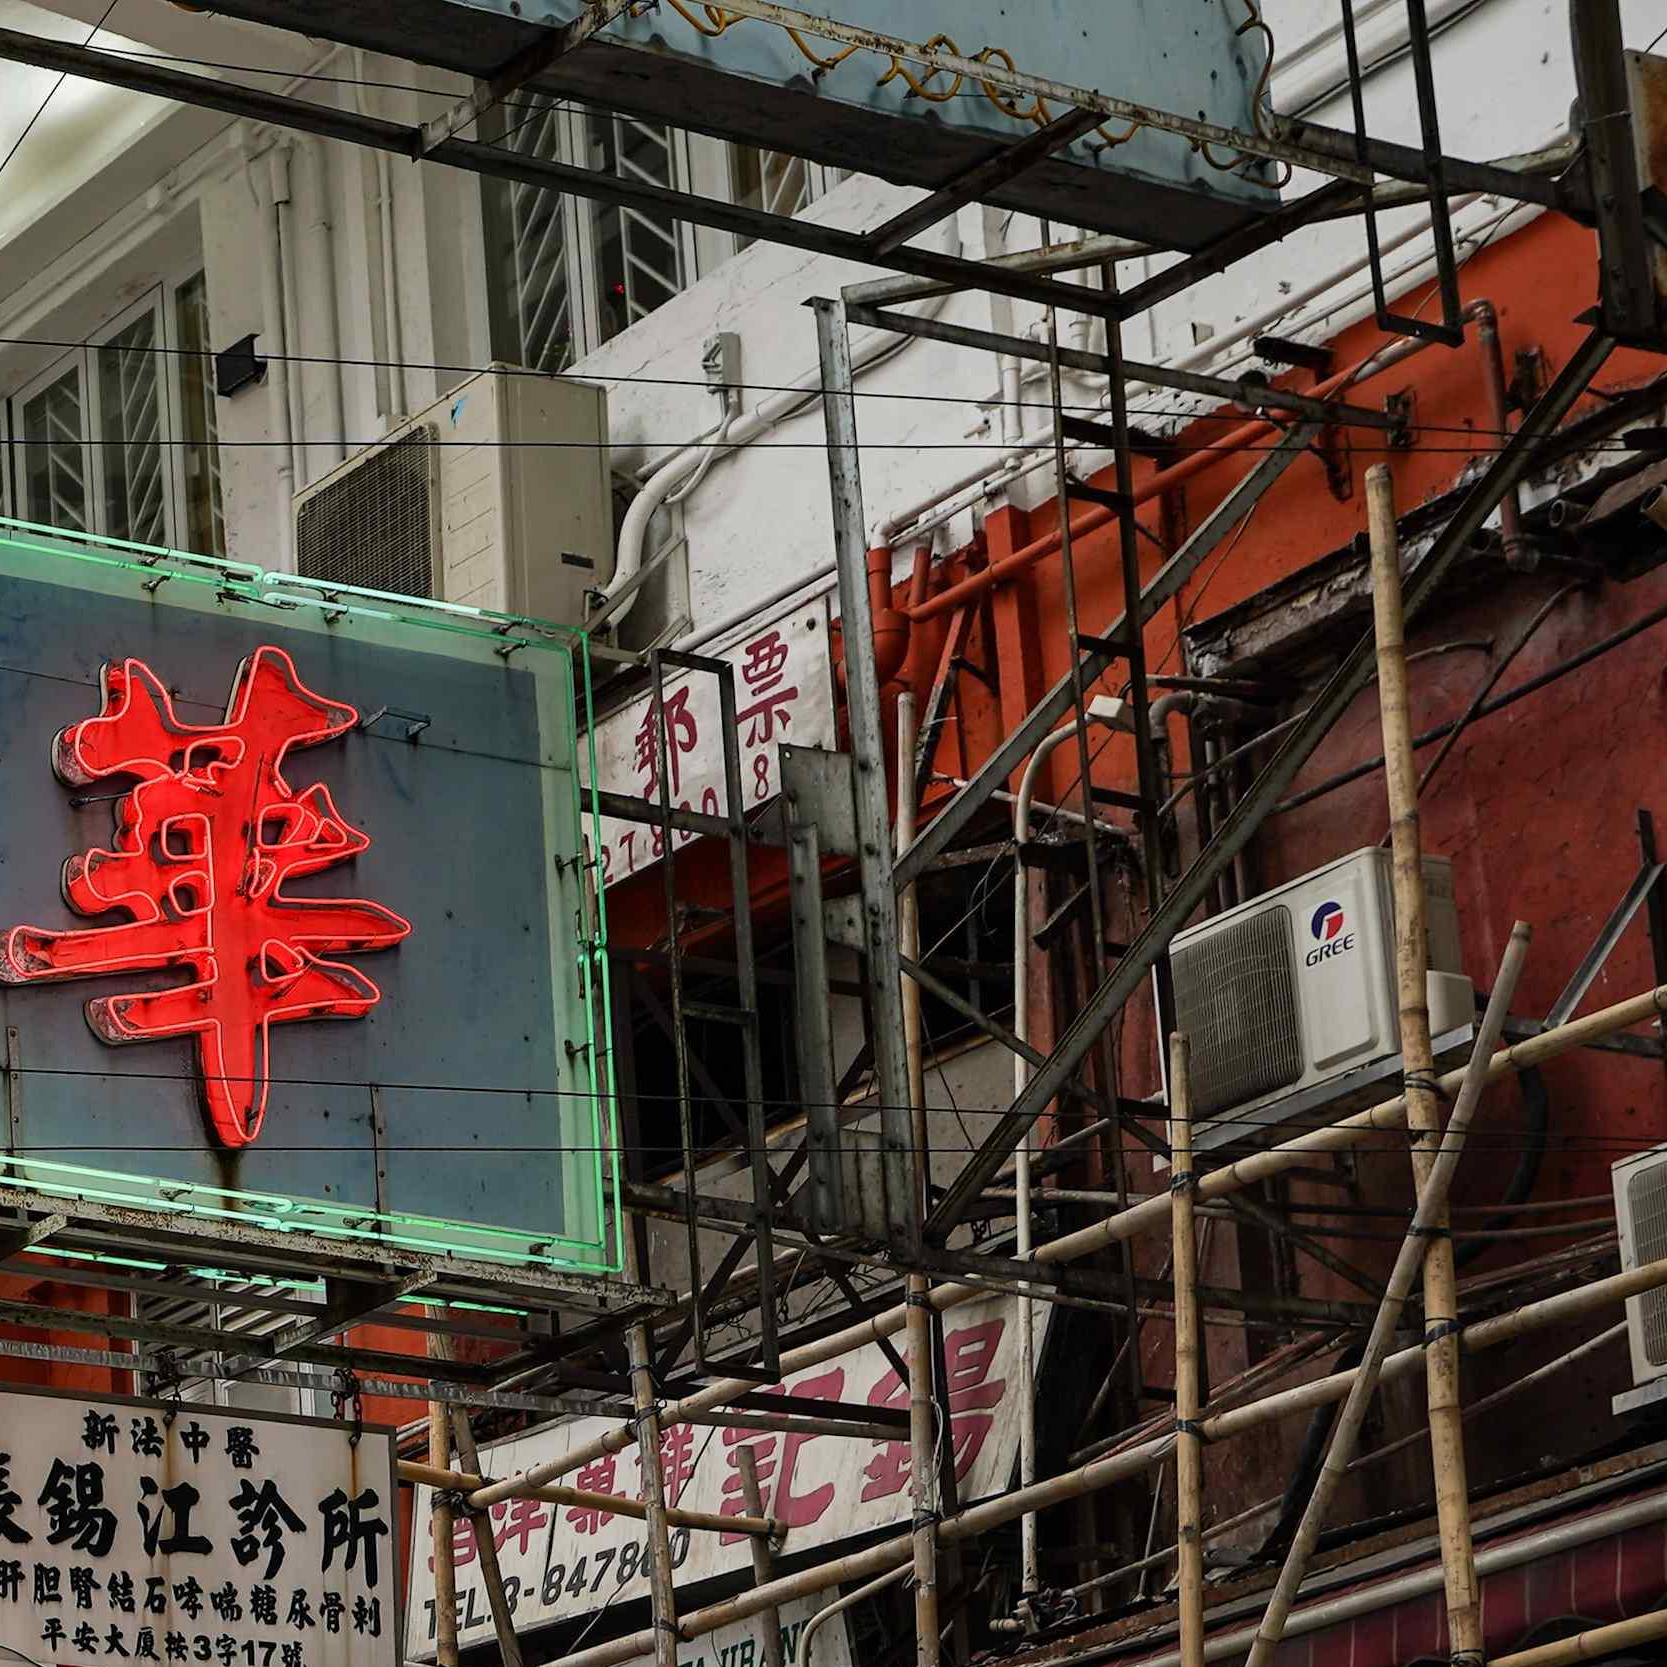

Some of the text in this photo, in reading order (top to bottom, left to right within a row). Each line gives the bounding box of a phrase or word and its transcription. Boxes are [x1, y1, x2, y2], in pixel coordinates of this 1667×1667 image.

[1305, 932, 1355, 968] GREE
[81, 1409, 260, 1470] 新法中醫
